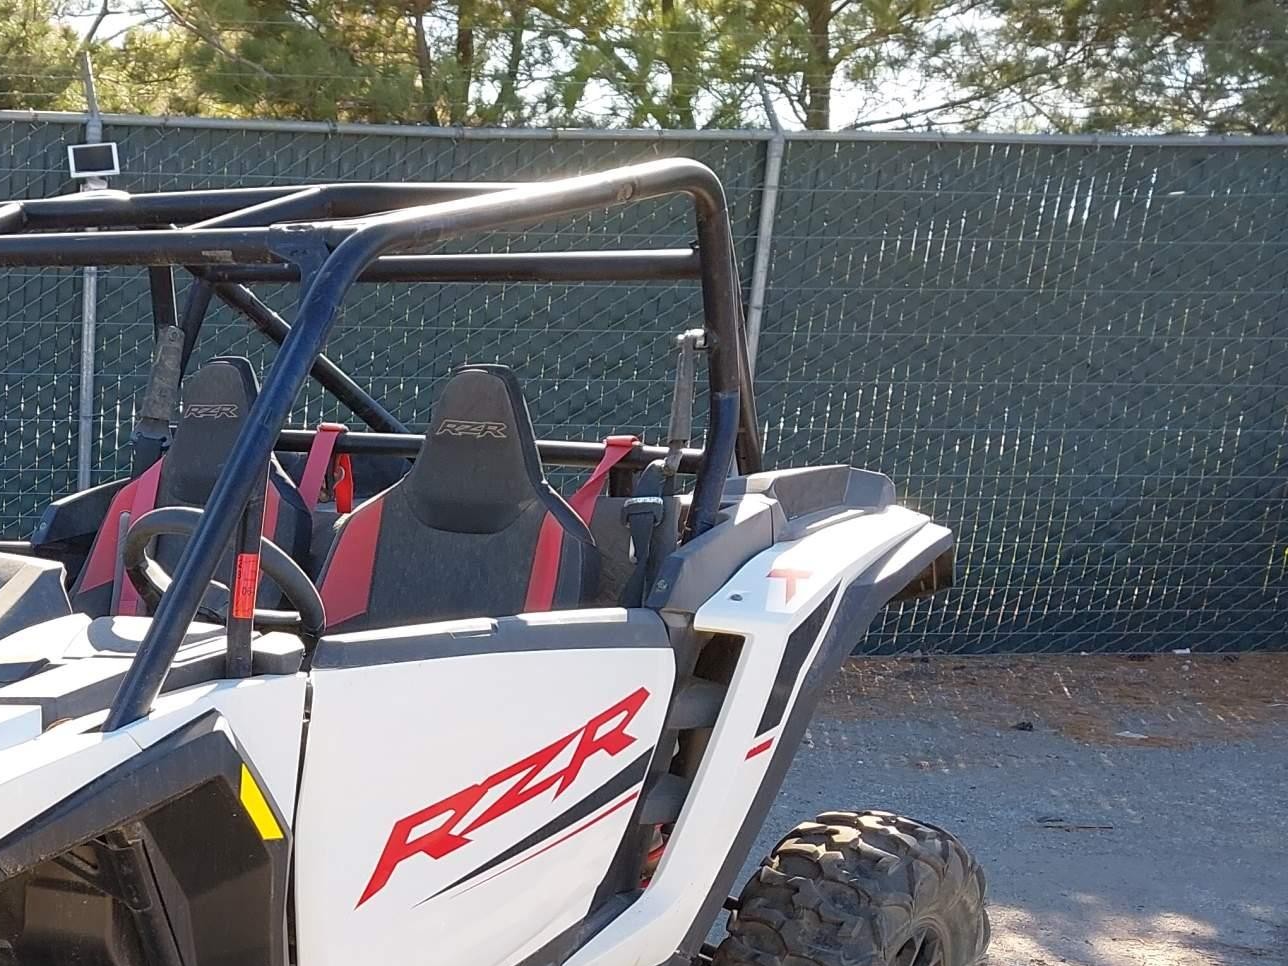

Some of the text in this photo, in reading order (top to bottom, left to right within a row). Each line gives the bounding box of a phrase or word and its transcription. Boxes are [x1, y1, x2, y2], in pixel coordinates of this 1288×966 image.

[184, 404, 239, 419] RZR
[436, 419, 507, 438] RZR
[354, 686, 650, 910] RZR
